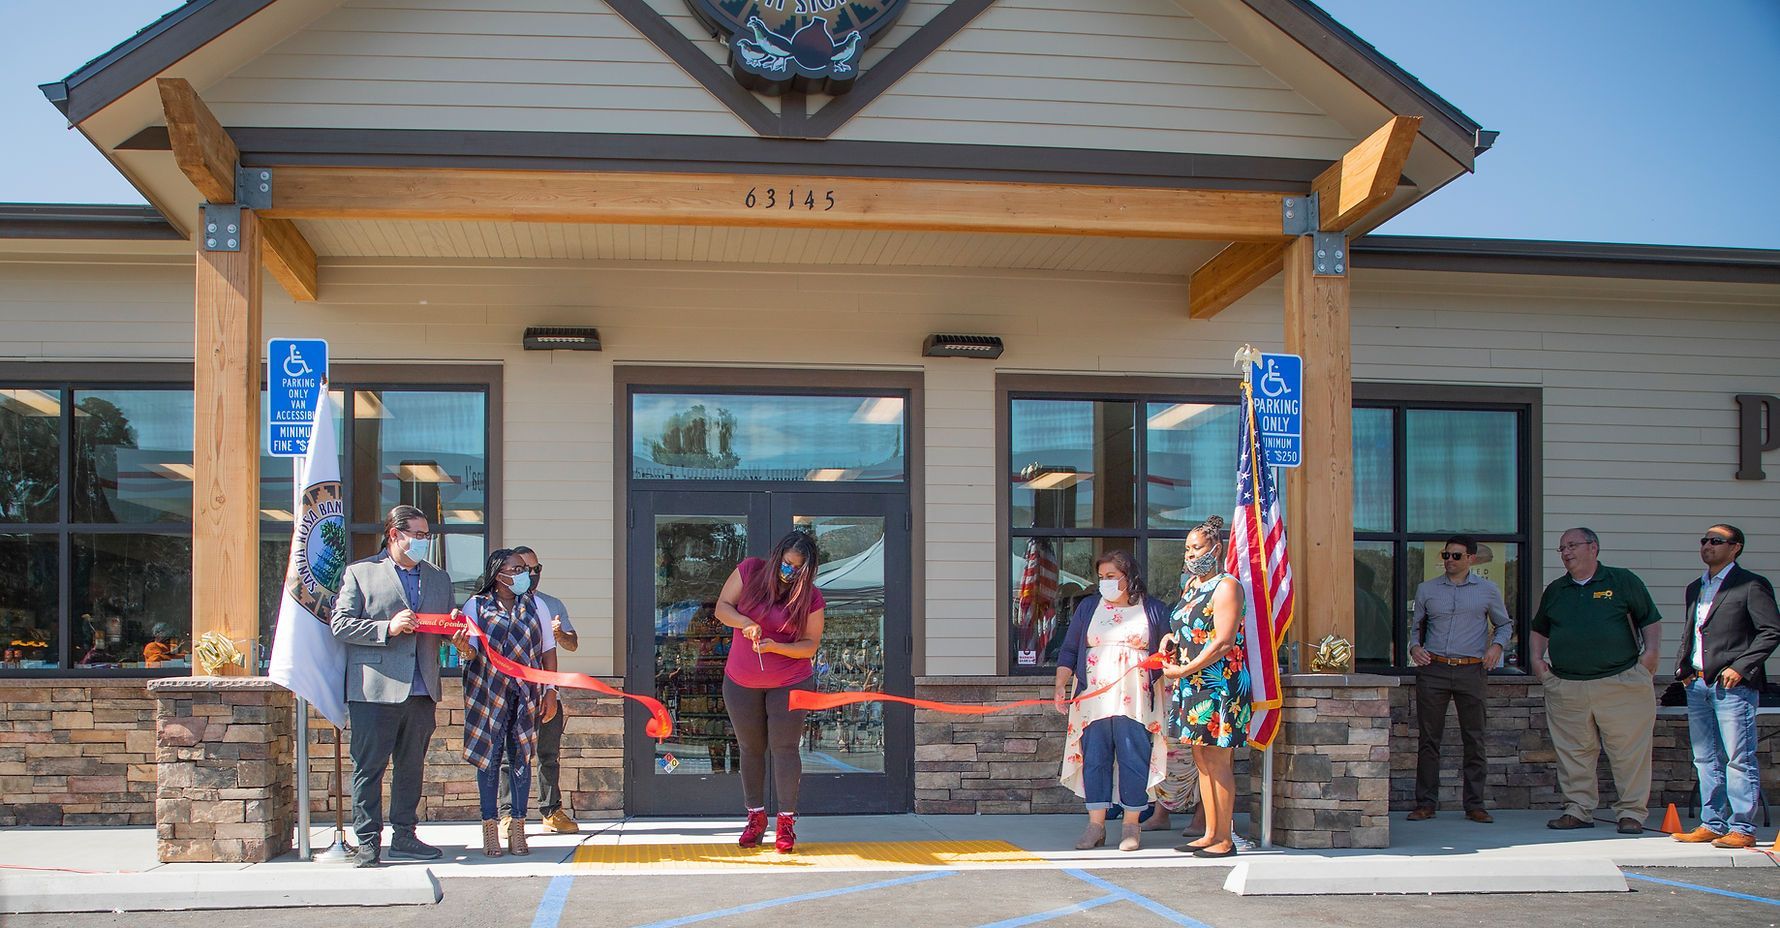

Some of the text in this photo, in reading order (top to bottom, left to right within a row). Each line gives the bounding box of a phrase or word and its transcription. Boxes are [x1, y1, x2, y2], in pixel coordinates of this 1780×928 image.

[745, 187, 835, 211] 63145
[282, 378, 315, 388] PARKING
[288, 389, 309, 399] ONLY
[290, 399, 306, 409] VAN
[1254, 398, 1298, 415] PARKING
[276, 410, 316, 420] ACCESSIB
[1262, 416, 1290, 432] ONLY
[280, 426, 311, 438] MINIMU
[273, 440, 293, 451] FINE
[1262, 437, 1292, 449] INIMUM
[318, 500, 343, 516] BAN
